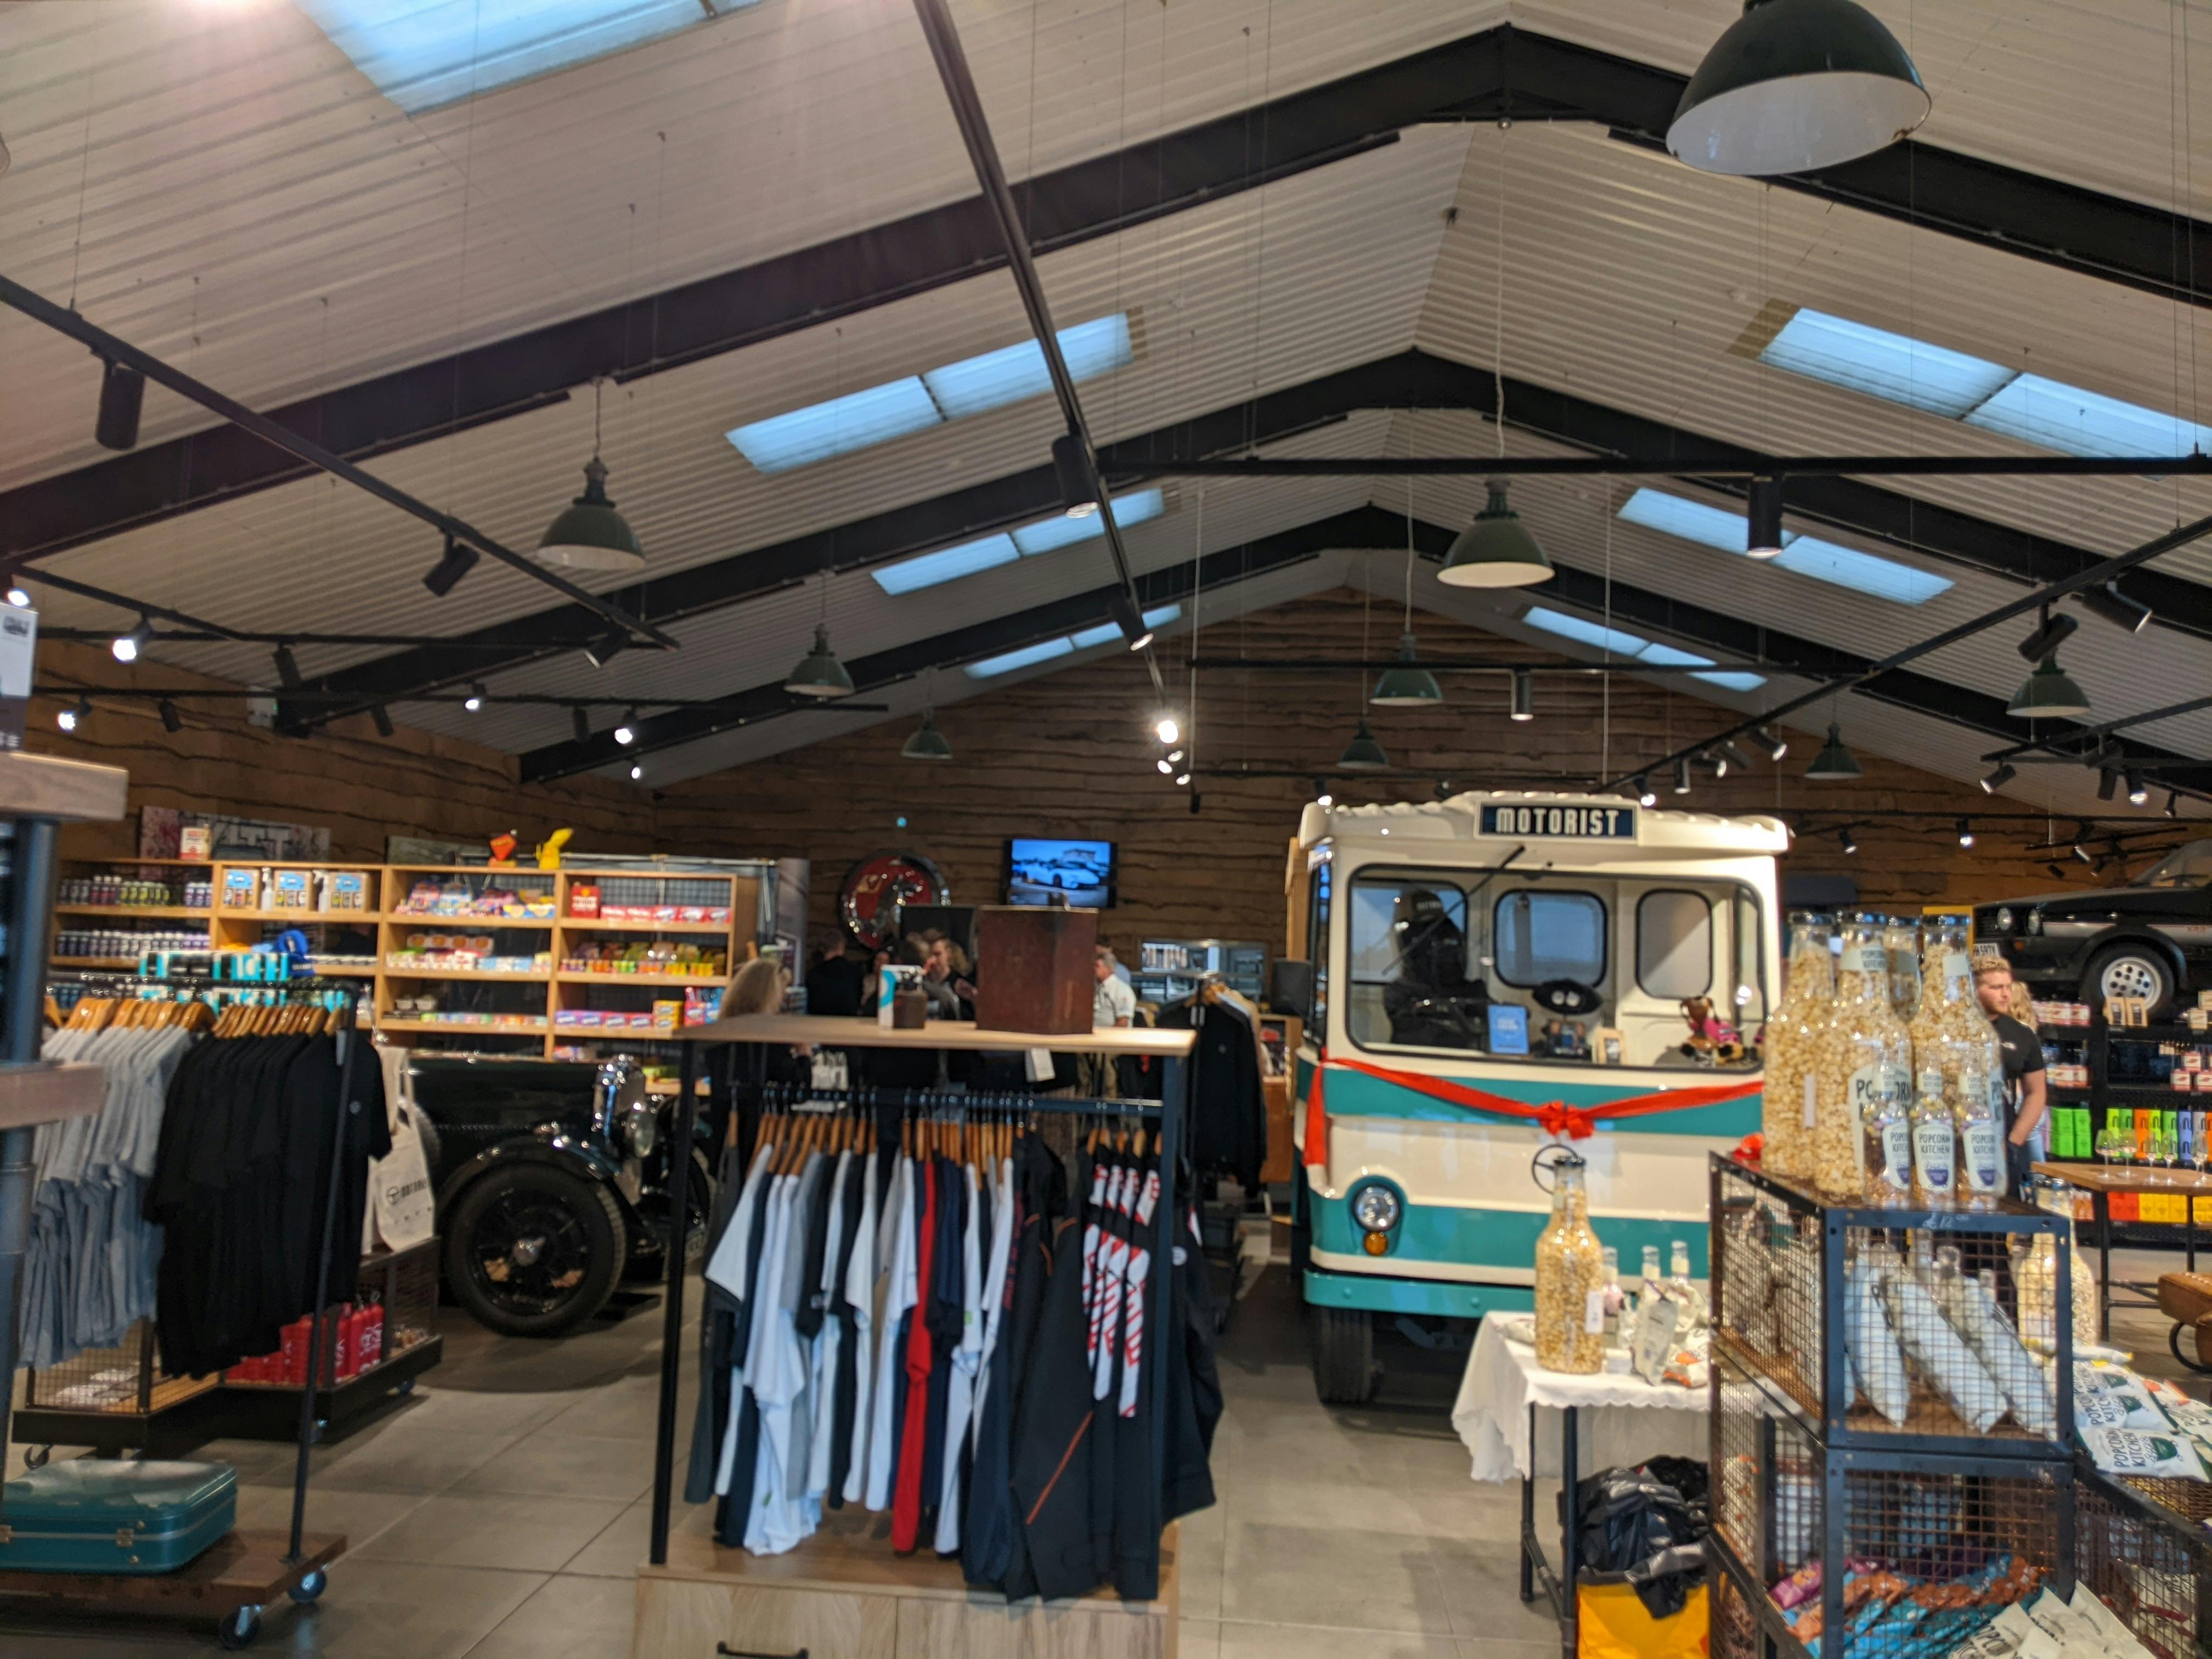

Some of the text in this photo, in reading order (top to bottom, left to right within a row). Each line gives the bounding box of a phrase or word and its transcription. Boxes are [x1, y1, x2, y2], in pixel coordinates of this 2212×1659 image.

[1495, 807, 1620, 836] MOTORIST
[1918, 1133, 1950, 1144] POPCORN
[1921, 1144, 1950, 1154] KITCHEN
[2106, 1428, 2130, 1468] POPCORN
[2123, 1432, 2147, 1468] KITCHEN
